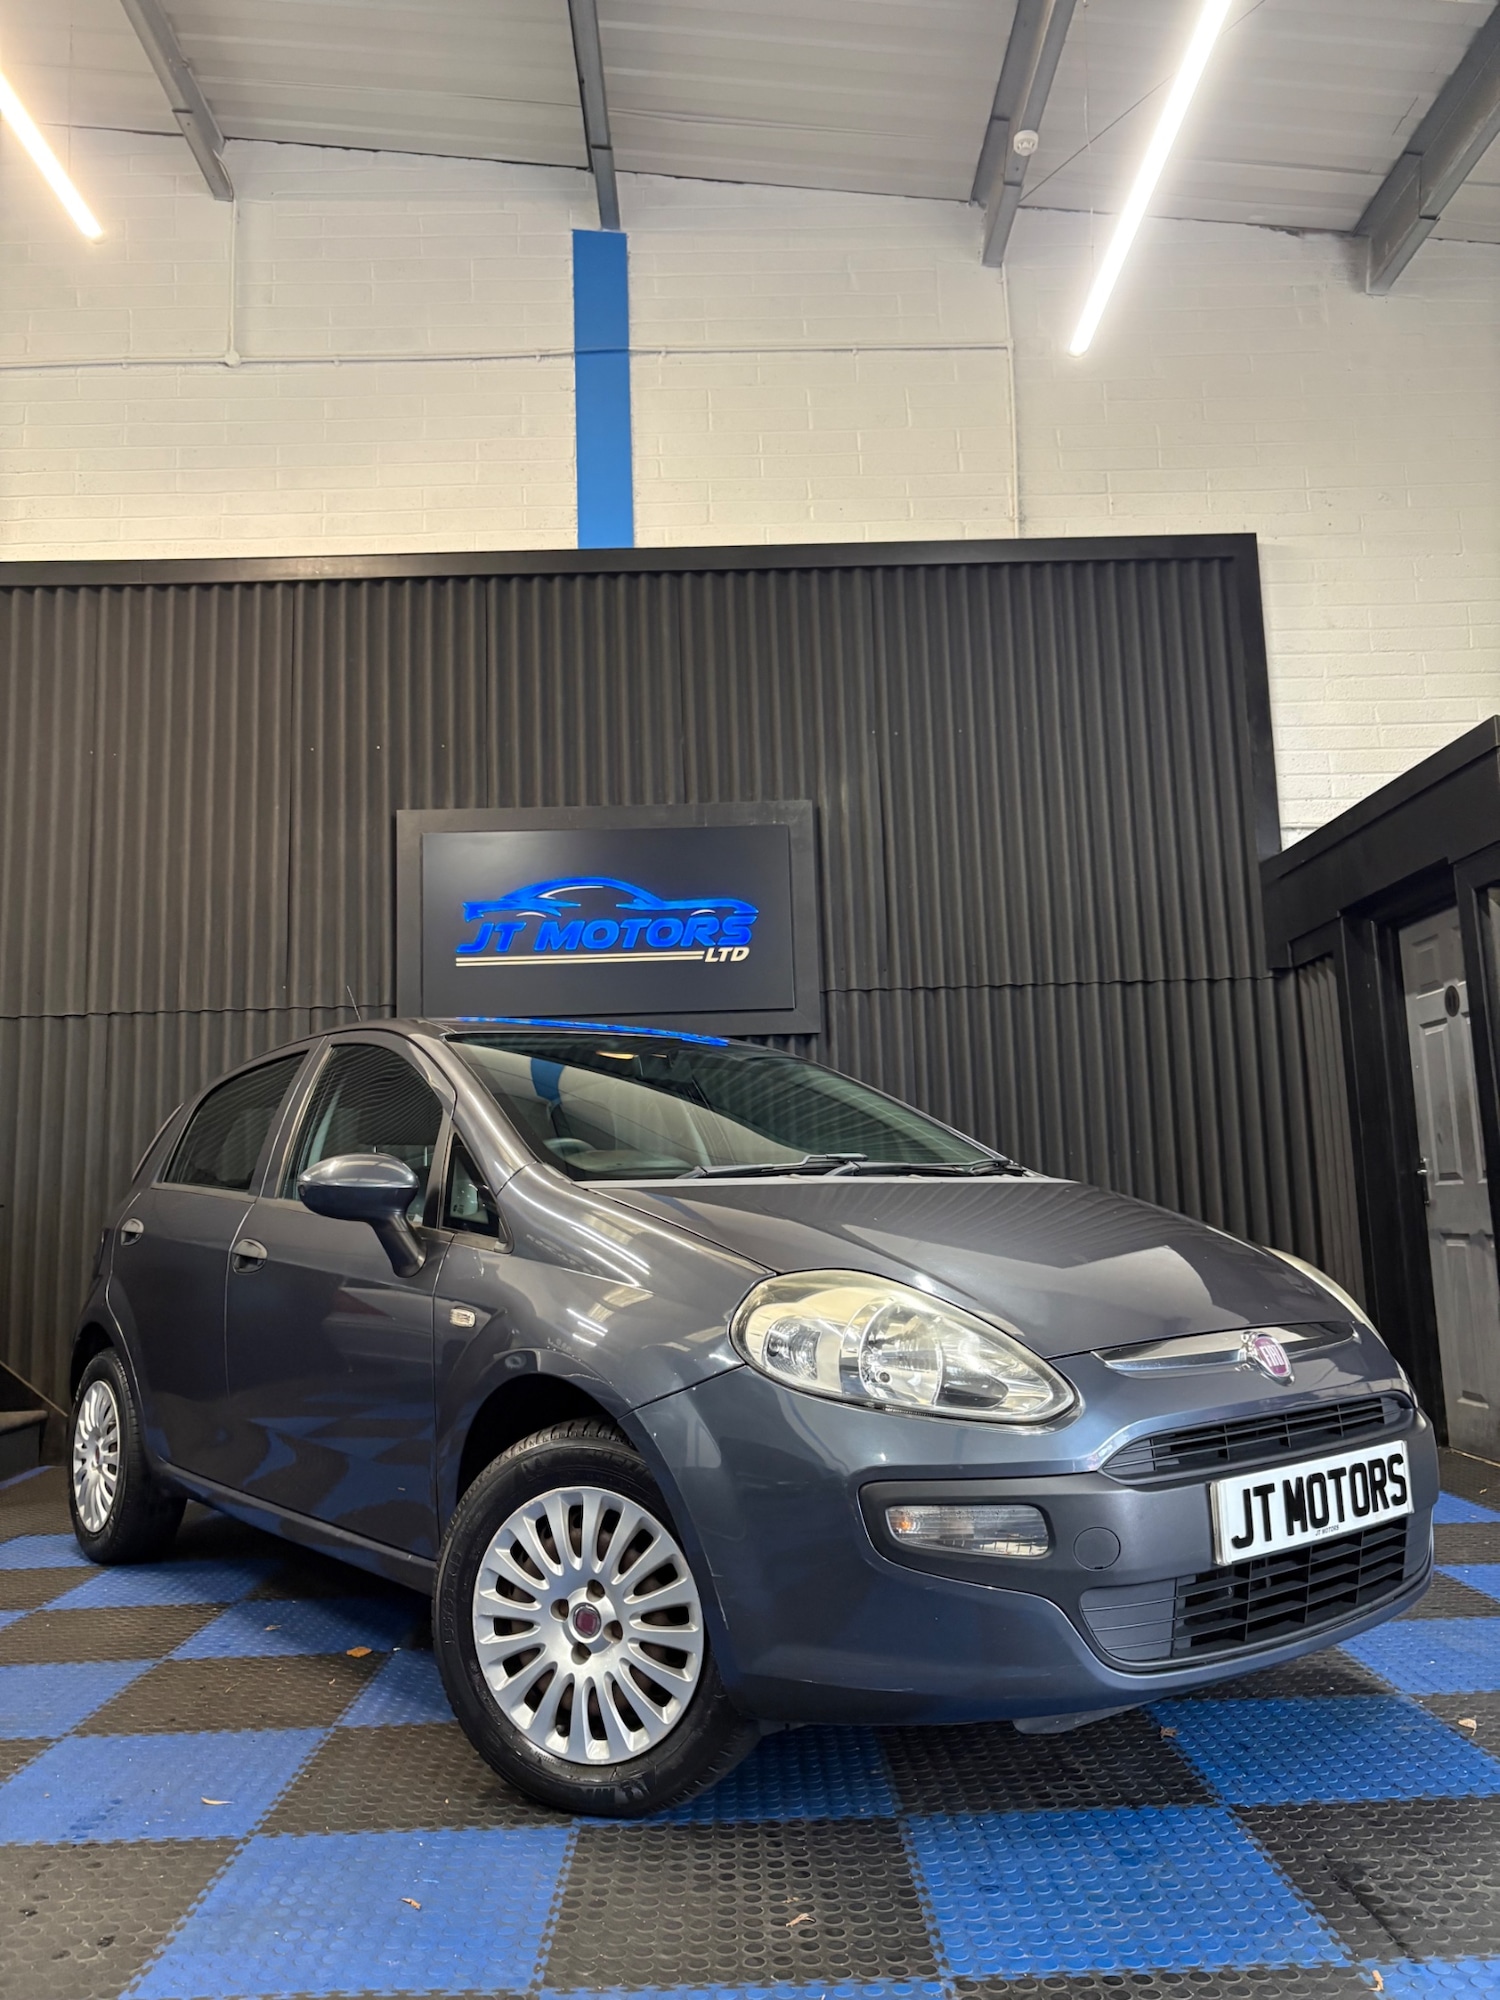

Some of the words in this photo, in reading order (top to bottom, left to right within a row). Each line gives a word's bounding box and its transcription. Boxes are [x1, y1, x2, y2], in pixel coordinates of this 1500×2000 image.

[456, 922, 526, 953] JT
[534, 916, 758, 951] MOTORS
[704, 946, 750, 964] LTD
[1231, 1483, 1276, 1549] JT
[1282, 1453, 1408, 1535] MOTORS
